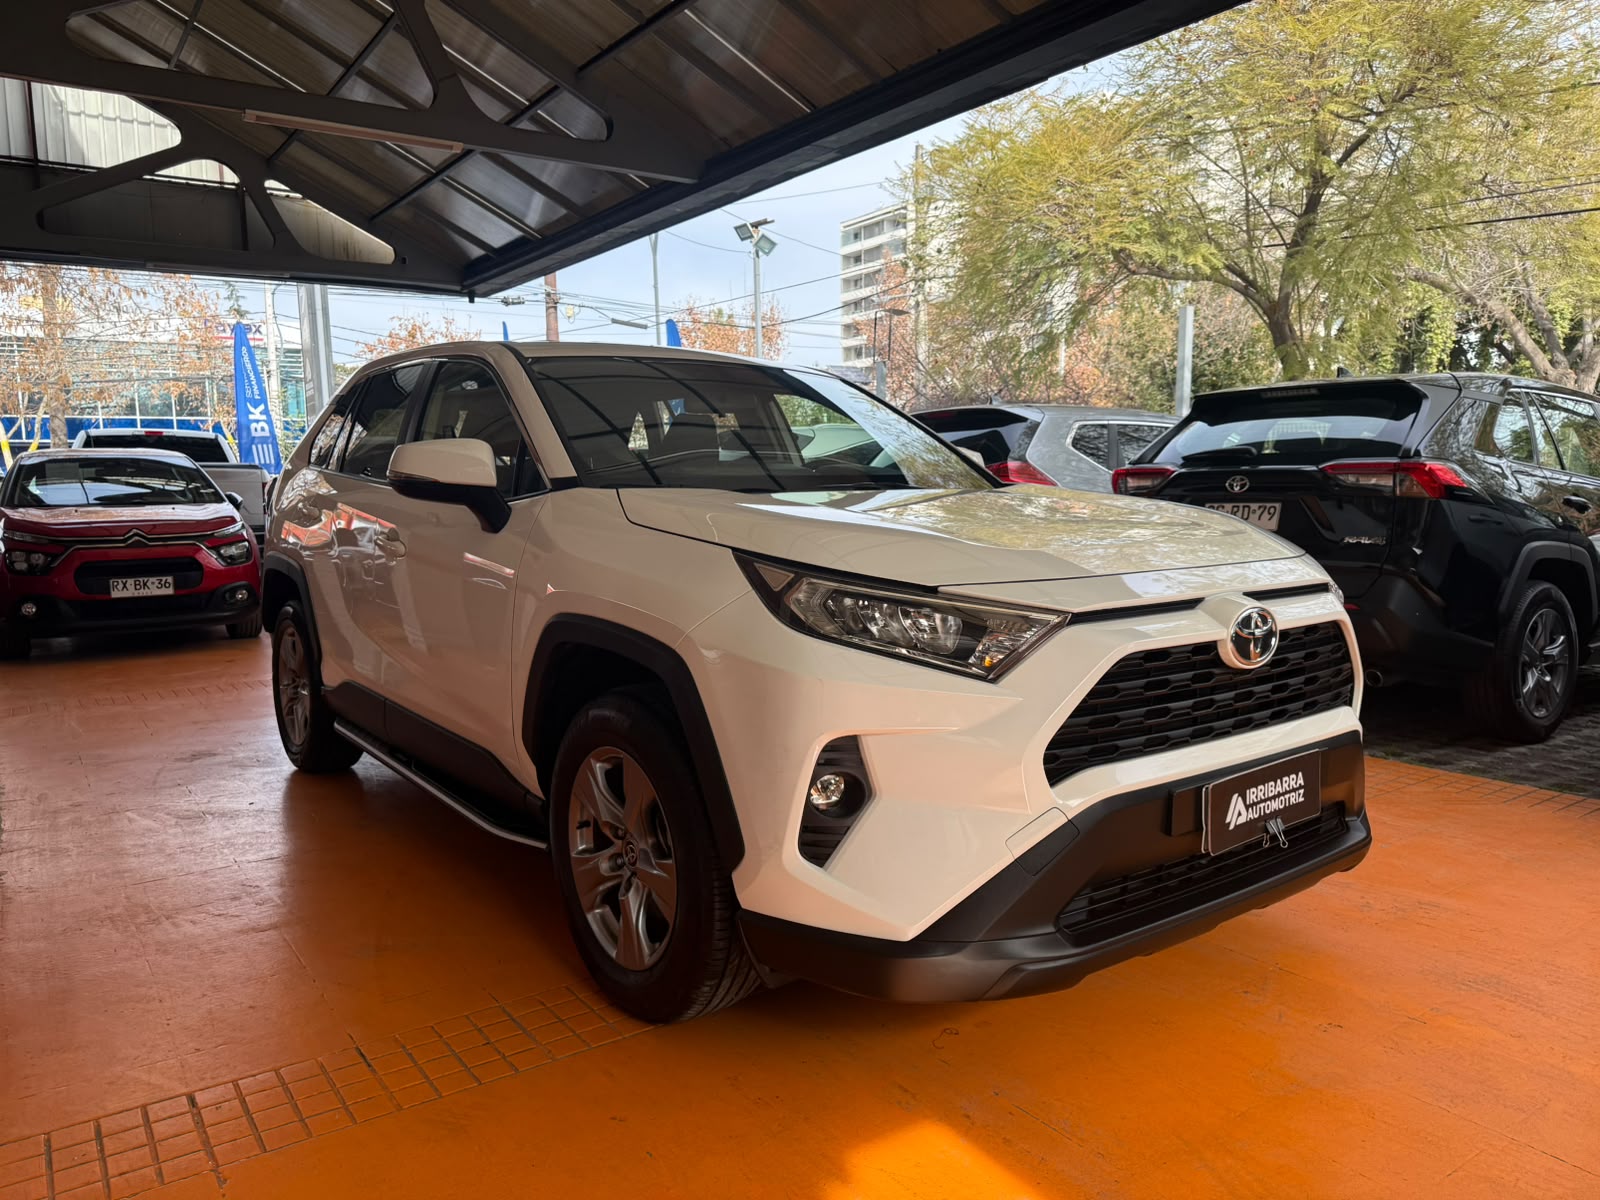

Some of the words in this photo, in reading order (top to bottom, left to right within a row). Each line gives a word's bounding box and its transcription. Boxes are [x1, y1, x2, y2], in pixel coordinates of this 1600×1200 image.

[242, 346, 260, 399] FINANCIEROS
[247, 402, 270, 437] BK
[1246, 772, 1305, 805] IRRIBARRA
[1246, 789, 1305, 821] AUTOMOTRIZ
